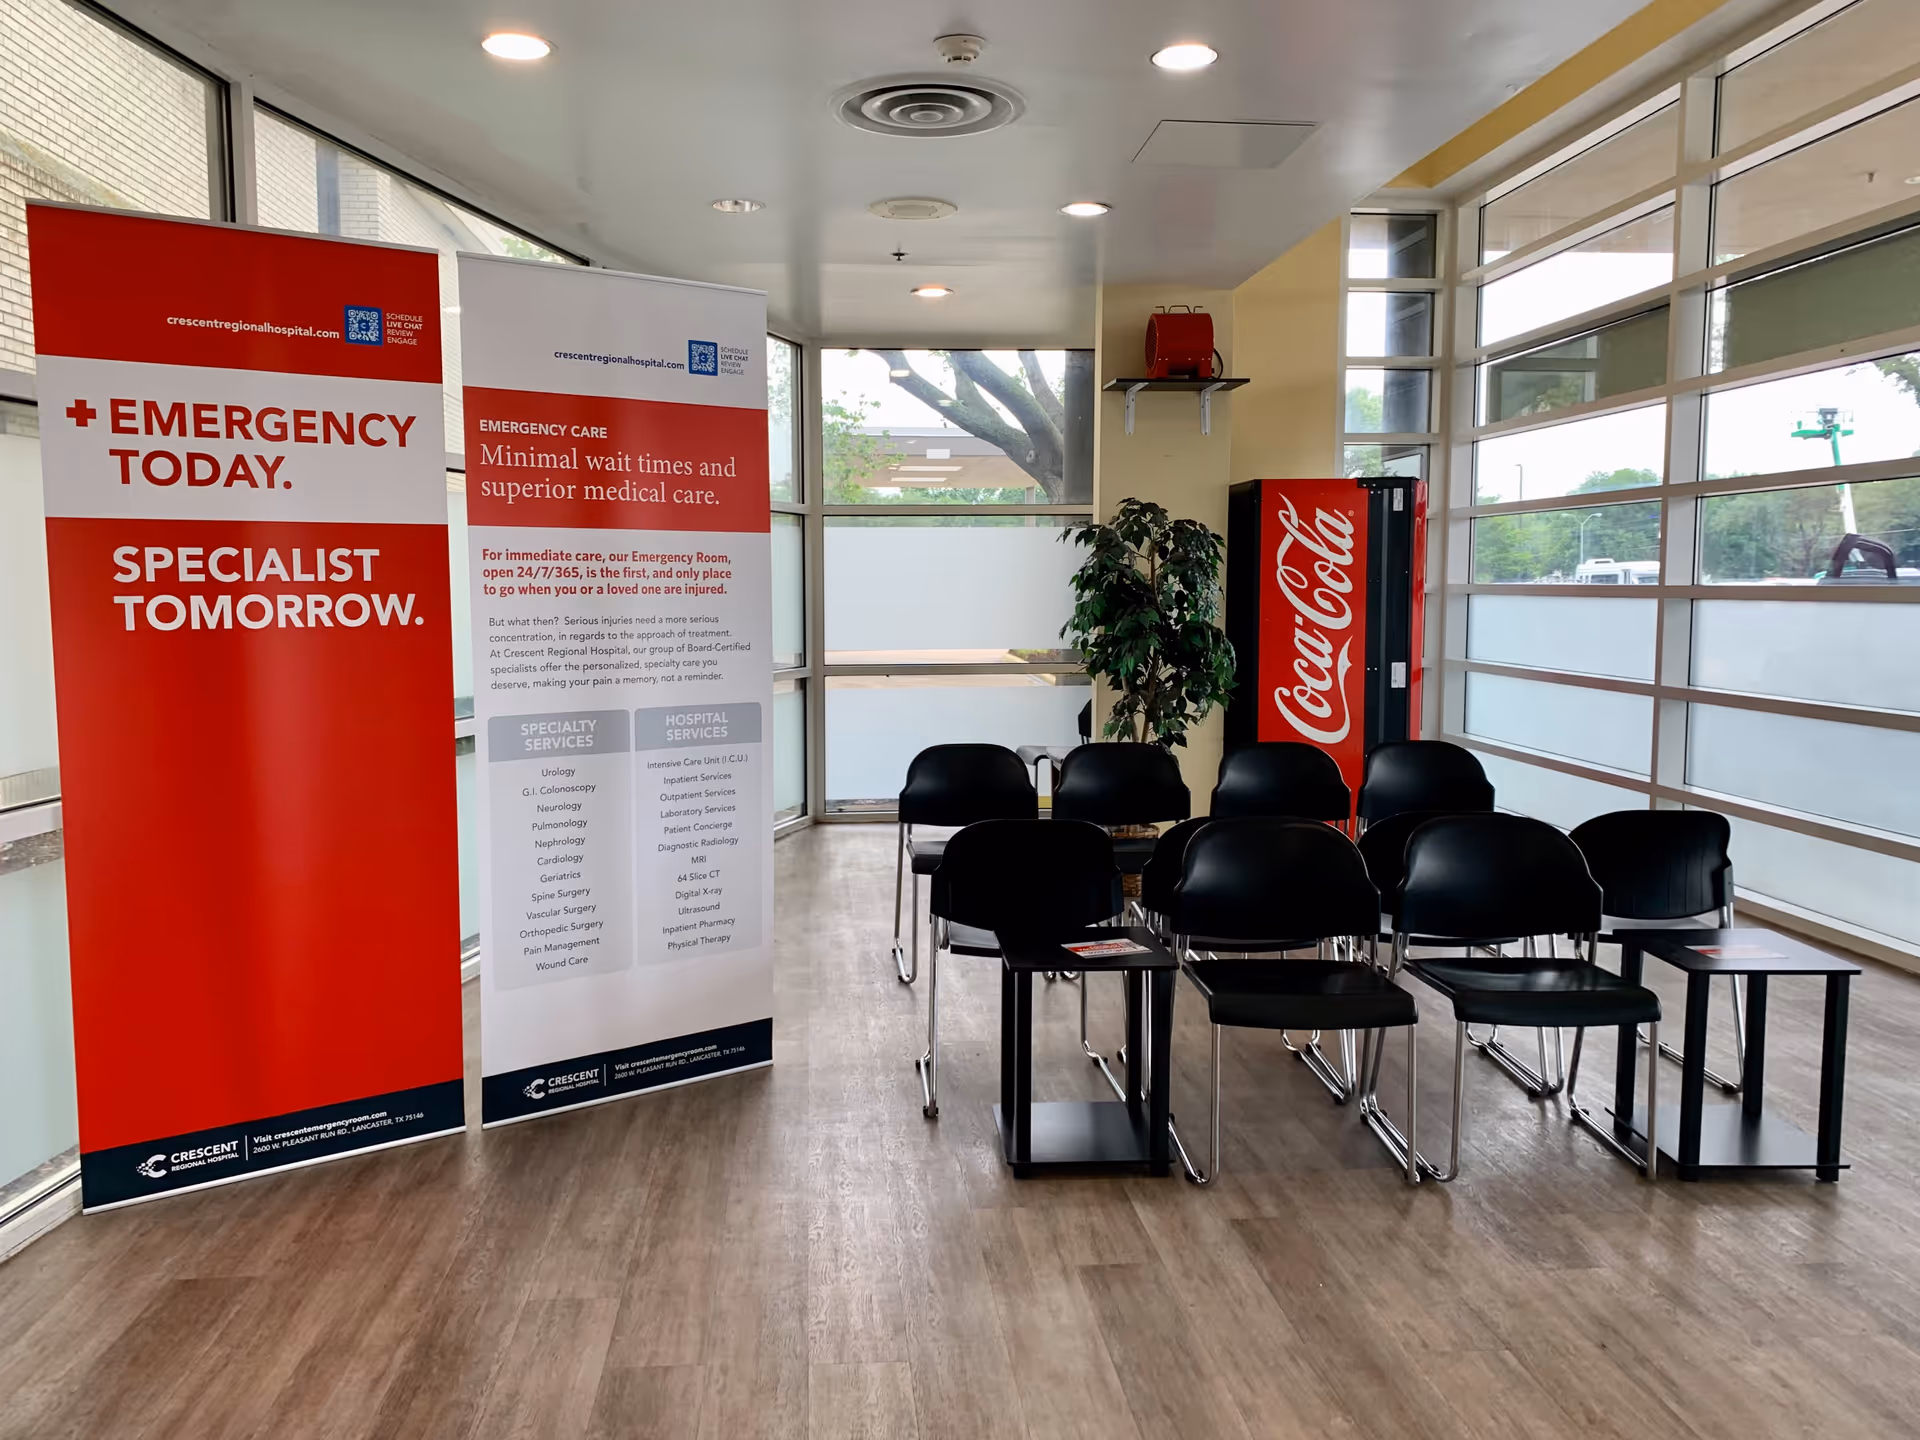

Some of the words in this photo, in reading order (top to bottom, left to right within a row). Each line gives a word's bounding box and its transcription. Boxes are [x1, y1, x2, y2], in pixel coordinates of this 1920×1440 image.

[386, 313, 423, 323] SCHEDULE
[387, 321, 402, 329] LIVE
[404, 322, 423, 330] CHAT
[167, 317, 340, 339] crescentregionalhospital.com
[387, 329, 414, 337] REVIEW
[387, 336, 418, 346] ENGAGE
[554, 351, 685, 370] crescentregionalhospital.com
[110, 398, 417, 448] EMERGENCY
[480, 420, 567, 436] EMERGENCY
[571, 426, 608, 439] CARE
[480, 443, 579, 470] Minimal
[585, 451, 632, 472] wait
[638, 453, 693, 476] times
[700, 456, 737, 478] and
[109, 448, 292, 490] TODAY.
[481, 478, 577, 505] superior
[584, 482, 666, 503] medical
[673, 489, 720, 505] care.
[113, 546, 380, 583] SPECIALIST
[482, 548, 503, 561] For
[506, 548, 572, 562] immediate
[575, 553, 606, 564] care,
[609, 553, 629, 562] our
[632, 551, 694, 566] Emergency
[696, 552, 731, 565] Room,
[483, 569, 514, 581] open
[517, 566, 583, 580] 24/7/365,
[586, 566, 597, 578] is
[600, 566, 620, 578] the
[623, 566, 650, 580] first,
[652, 567, 673, 579] and
[676, 567, 700, 581] only
[703, 568, 732, 581] place
[483, 584, 497, 595] to
[500, 586, 515, 598] go
[518, 583, 551, 595] when
[554, 586, 577, 598] you
[580, 586, 594, 595] or
[596, 586, 604, 595] a
[607, 583, 639, 595] loved
[641, 586, 662, 595] one
[664, 586, 682, 595] are
[685, 583, 727, 597] injured.
[113, 593, 424, 631] TOMORROW.
[489, 617, 505, 627] But
[507, 617, 530, 627] what
[532, 616, 560, 626] then?
[564, 616, 599, 626] Serious
[601, 616, 633, 627] injuries
[635, 615, 656, 624] need
[689, 615, 719, 624] serious
[489, 632, 556, 643] concentration,
[558, 632, 567, 641] in
[570, 631, 606, 643] regards
[607, 632, 618, 640] to
[620, 630, 635, 640] the
[636, 629, 675, 641] approach
[677, 629, 686, 638] of
[688, 630, 732, 638] treatment.
[490, 649, 501, 658] At
[504, 648, 545, 658] Crescent
[548, 646, 588, 659] Regional
[590, 645, 631, 658] Hospital,
[649, 646, 674, 656] group
[676, 643, 686, 653] of
[687, 642, 751, 653] Board-Certified
[490, 664, 538, 677] specialists
[540, 662, 562, 672] offer
[564, 662, 580, 672] the
[582, 660, 642, 674] personalized,
[644, 659, 681, 671] specialty
[702, 659, 718, 669] you
[491, 680, 530, 690] deserve,
[533, 678, 567, 689] making
[569, 679, 591, 689] your
[592, 676, 613, 689] pain
[623, 676, 659, 685] memory,
[661, 674, 675, 682] not
[684, 672, 724, 682] reminder.
[666, 712, 729, 726] HOSPITAL
[521, 720, 597, 736] SPECIALTY
[666, 726, 728, 741] SERVICES
[525, 735, 594, 751] SERVICES
[647, 760, 682, 769] Intensive
[683, 758, 702, 767] Care
[704, 757, 720, 765] Unit
[722, 754, 749, 765] (I.C.U.)
[542, 767, 576, 778] Urology
[664, 775, 698, 786] Inpatient
[700, 772, 732, 782] Services
[522, 787, 538, 797] G.I.
[540, 784, 597, 795] Colonoscopy
[660, 792, 703, 802] Outpatient
[704, 789, 736, 798] Services
[537, 802, 582, 813] Neurology
[660, 809, 703, 819] Laboratory
[704, 804, 736, 814] Services
[532, 819, 588, 831] Pulmonology
[664, 825, 691, 834] Patient
[693, 822, 733, 832] Concierge
[535, 836, 586, 849] Nephrology
[658, 841, 699, 852] Diagnostic
[701, 837, 739, 847] Radiology
[537, 854, 584, 866] Cardiology
[691, 855, 707, 864] MRI
[540, 871, 582, 883] Geriatrics
[677, 874, 688, 883] 64
[689, 872, 708, 882] Slice
[709, 869, 721, 879] CT
[532, 892, 556, 903] Spine
[557, 888, 591, 899] Surgery
[676, 888, 701, 900] Digital
[703, 888, 723, 896] X-ray
[526, 908, 561, 920] Vascular
[563, 904, 597, 915] Surgery
[678, 902, 721, 916] Ultrasound
[520, 924, 569, 939] Orthopedic
[570, 921, 604, 931] Surgery
[662, 923, 697, 935] Inpatient
[699, 918, 736, 929] Pharmacy
[524, 946, 542, 956] Pain
[544, 937, 600, 952] Management
[668, 938, 699, 951] Physical
[700, 935, 731, 945] Therapy
[536, 958, 567, 971] Wound
[568, 957, 589, 966] Care
[253, 1134, 273, 1144] Visit
[274, 1111, 387, 1140] crescentemergencyroom.com
[253, 1144, 271, 1154] 2600
[271, 1142, 281, 1150] W.
[282, 1134, 319, 1147] PLEASANT
[320, 1129, 336, 1139] RUN
[352, 1118, 394, 1133] LANCASTER,
[405, 1112, 424, 1121] 75146
[171, 1140, 239, 1163] CRESCENT
[172, 1160, 207, 1172] REGIONAL
[208, 1152, 239, 1164] HOSPITAL
